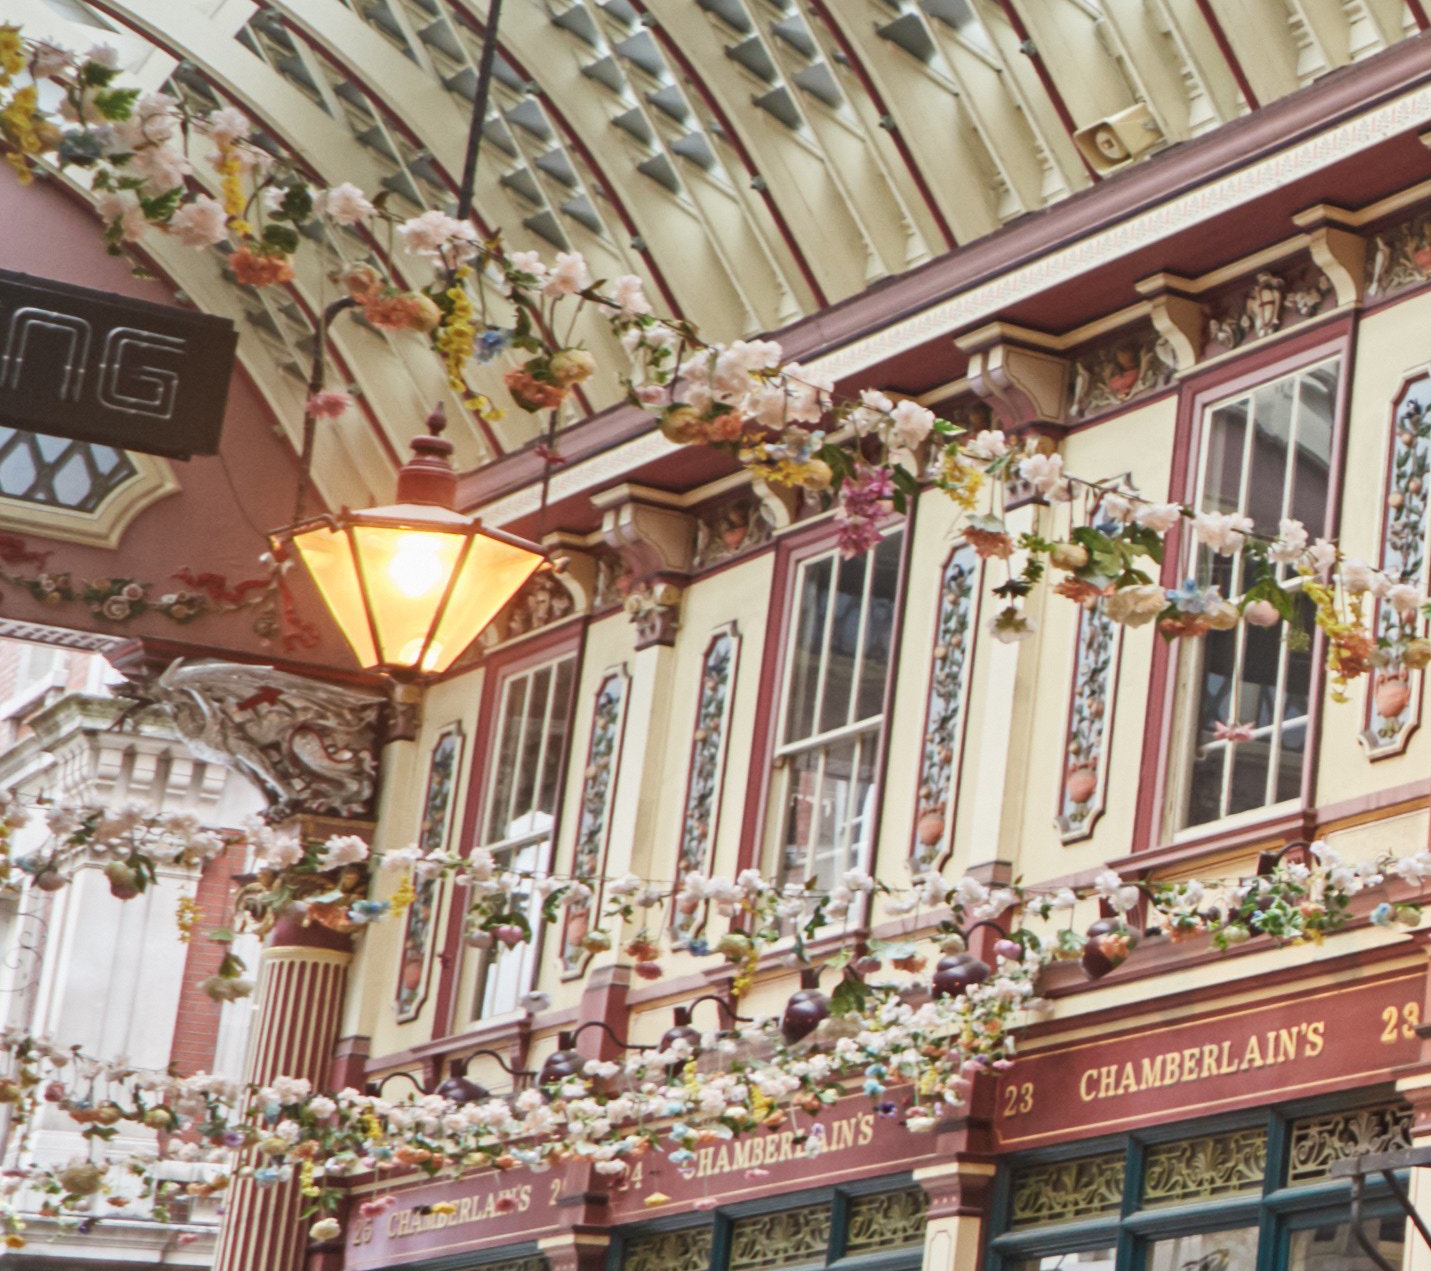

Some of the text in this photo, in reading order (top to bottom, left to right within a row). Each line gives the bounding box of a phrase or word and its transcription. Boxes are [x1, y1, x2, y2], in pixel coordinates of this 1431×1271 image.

[1002, 1002, 1420, 1118] 23 CHAMBERLAIN'S 23
